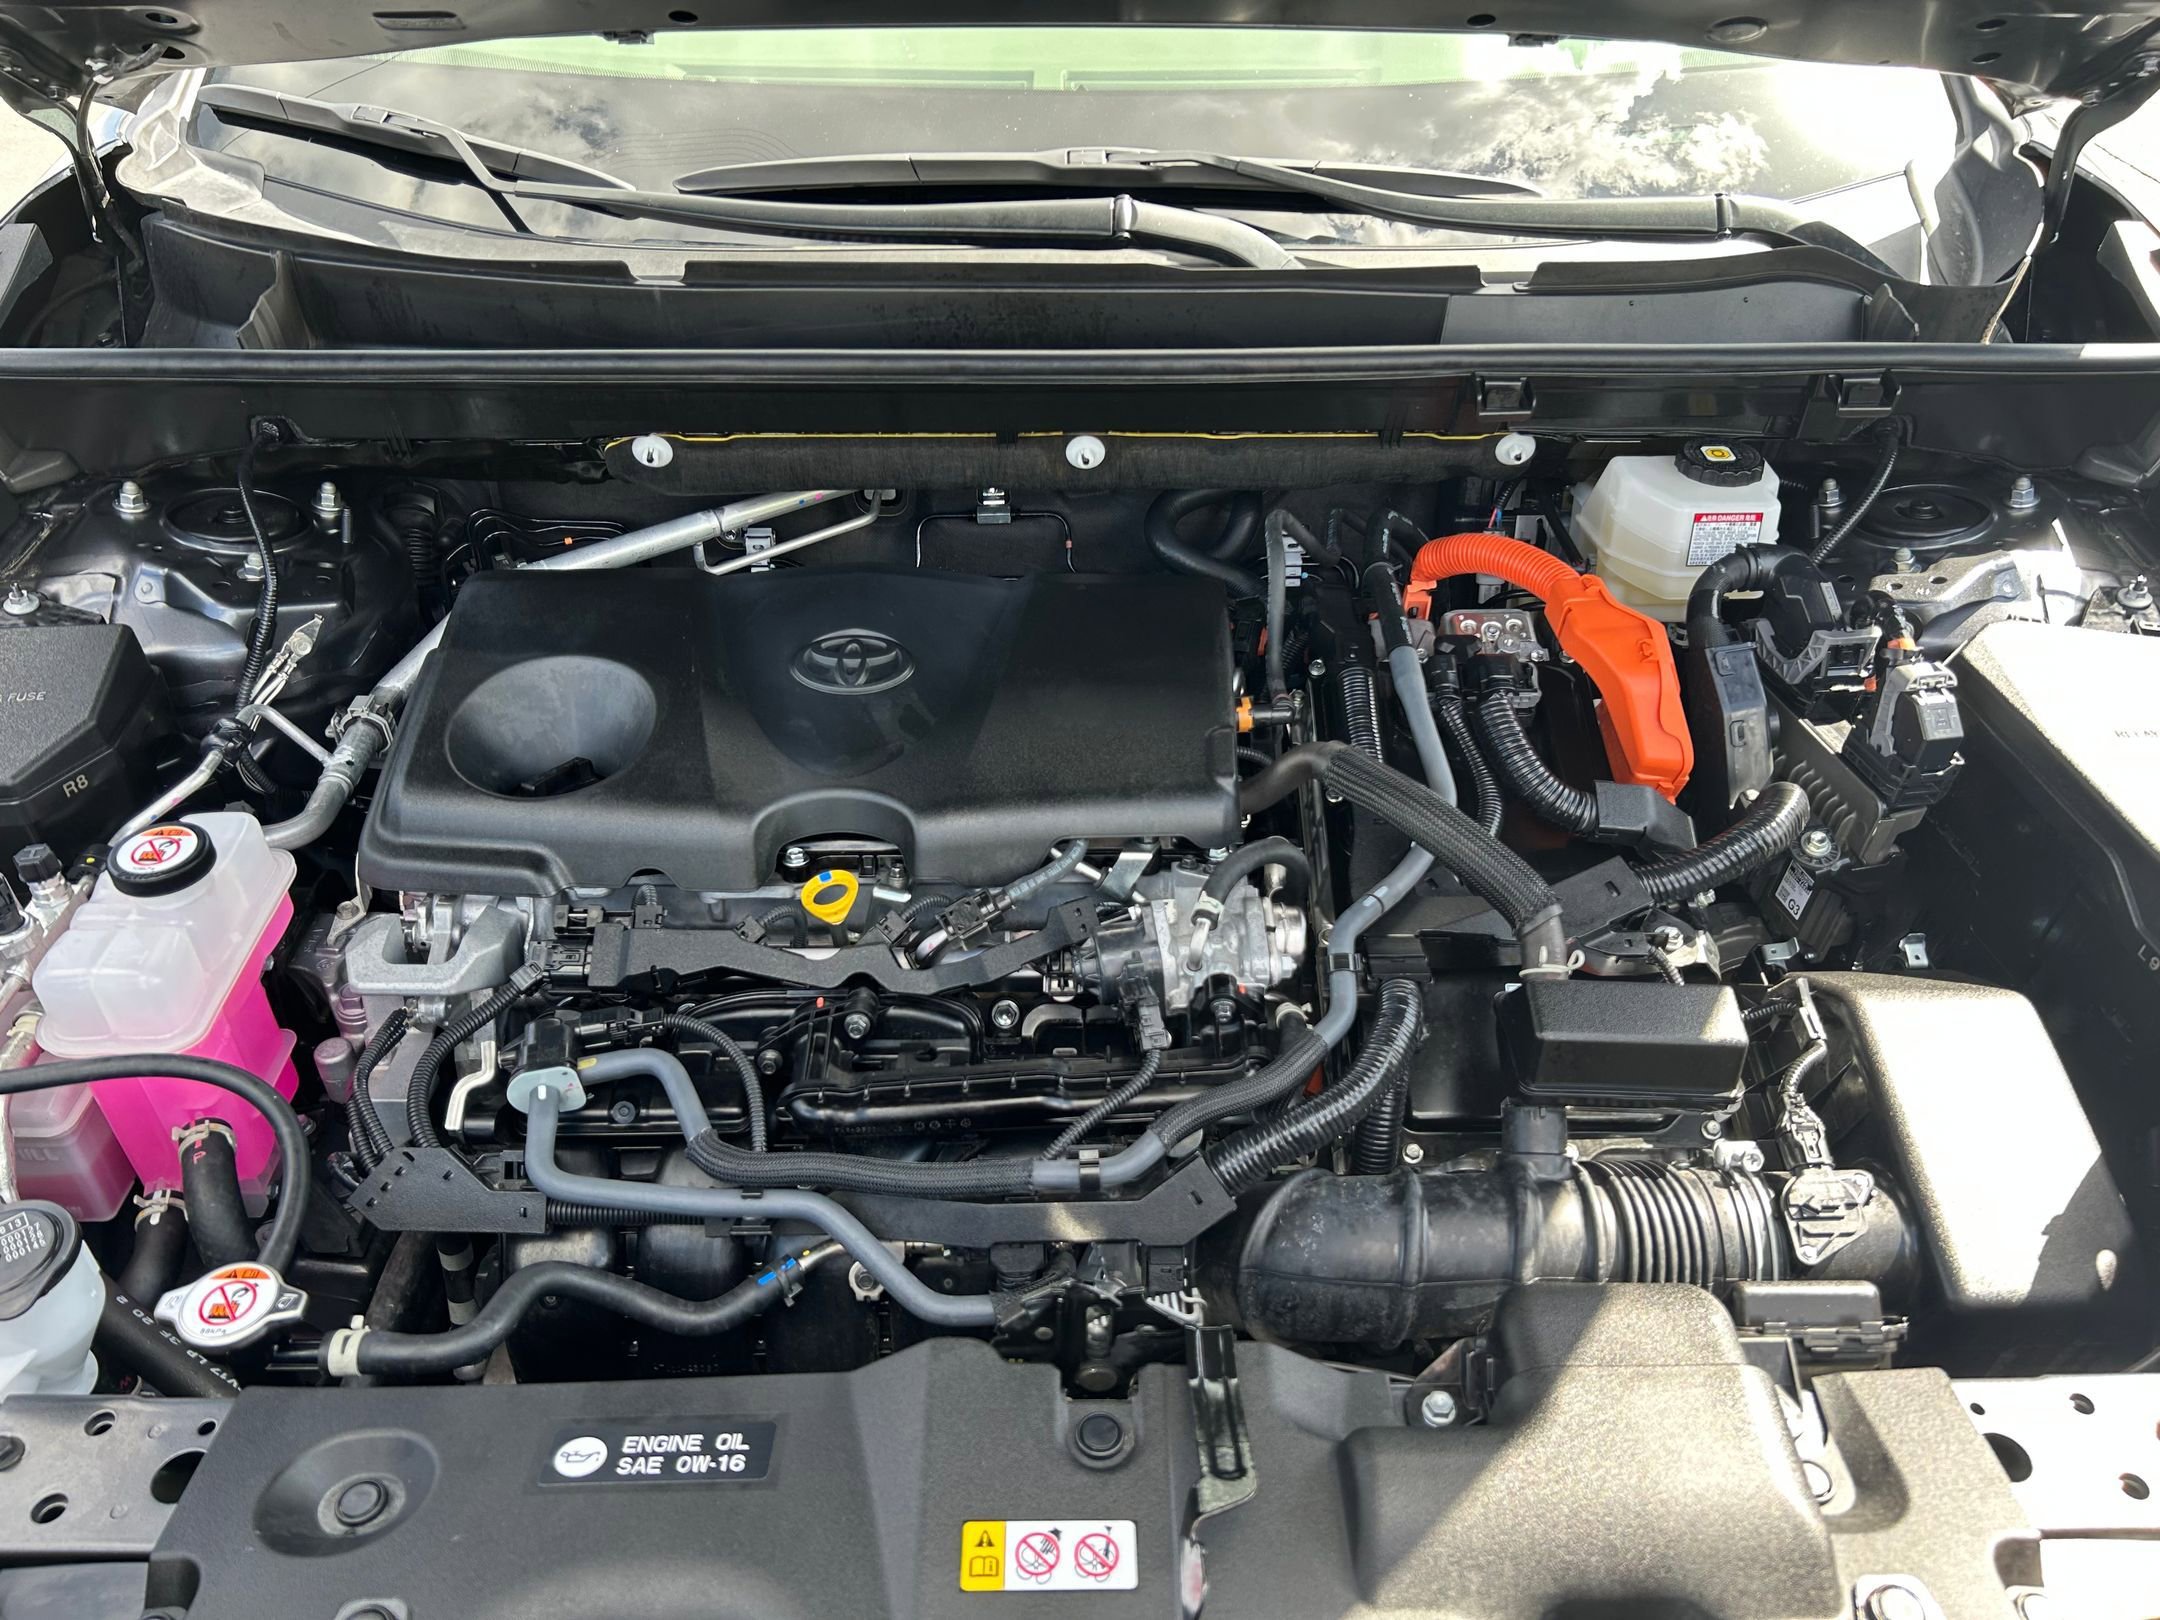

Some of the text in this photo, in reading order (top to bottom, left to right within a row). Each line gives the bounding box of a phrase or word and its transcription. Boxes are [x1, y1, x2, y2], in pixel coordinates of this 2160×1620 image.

[1717, 514, 1745, 522] DANGER
[7, 691, 46, 702] FUSE
[62, 774, 89, 798] R8
[1788, 898, 1801, 916] G3
[186, 1349, 208, 1365] LP
[622, 1433, 750, 1453] ENGINE OIL
[615, 1454, 746, 1475] SAE 0W-16
